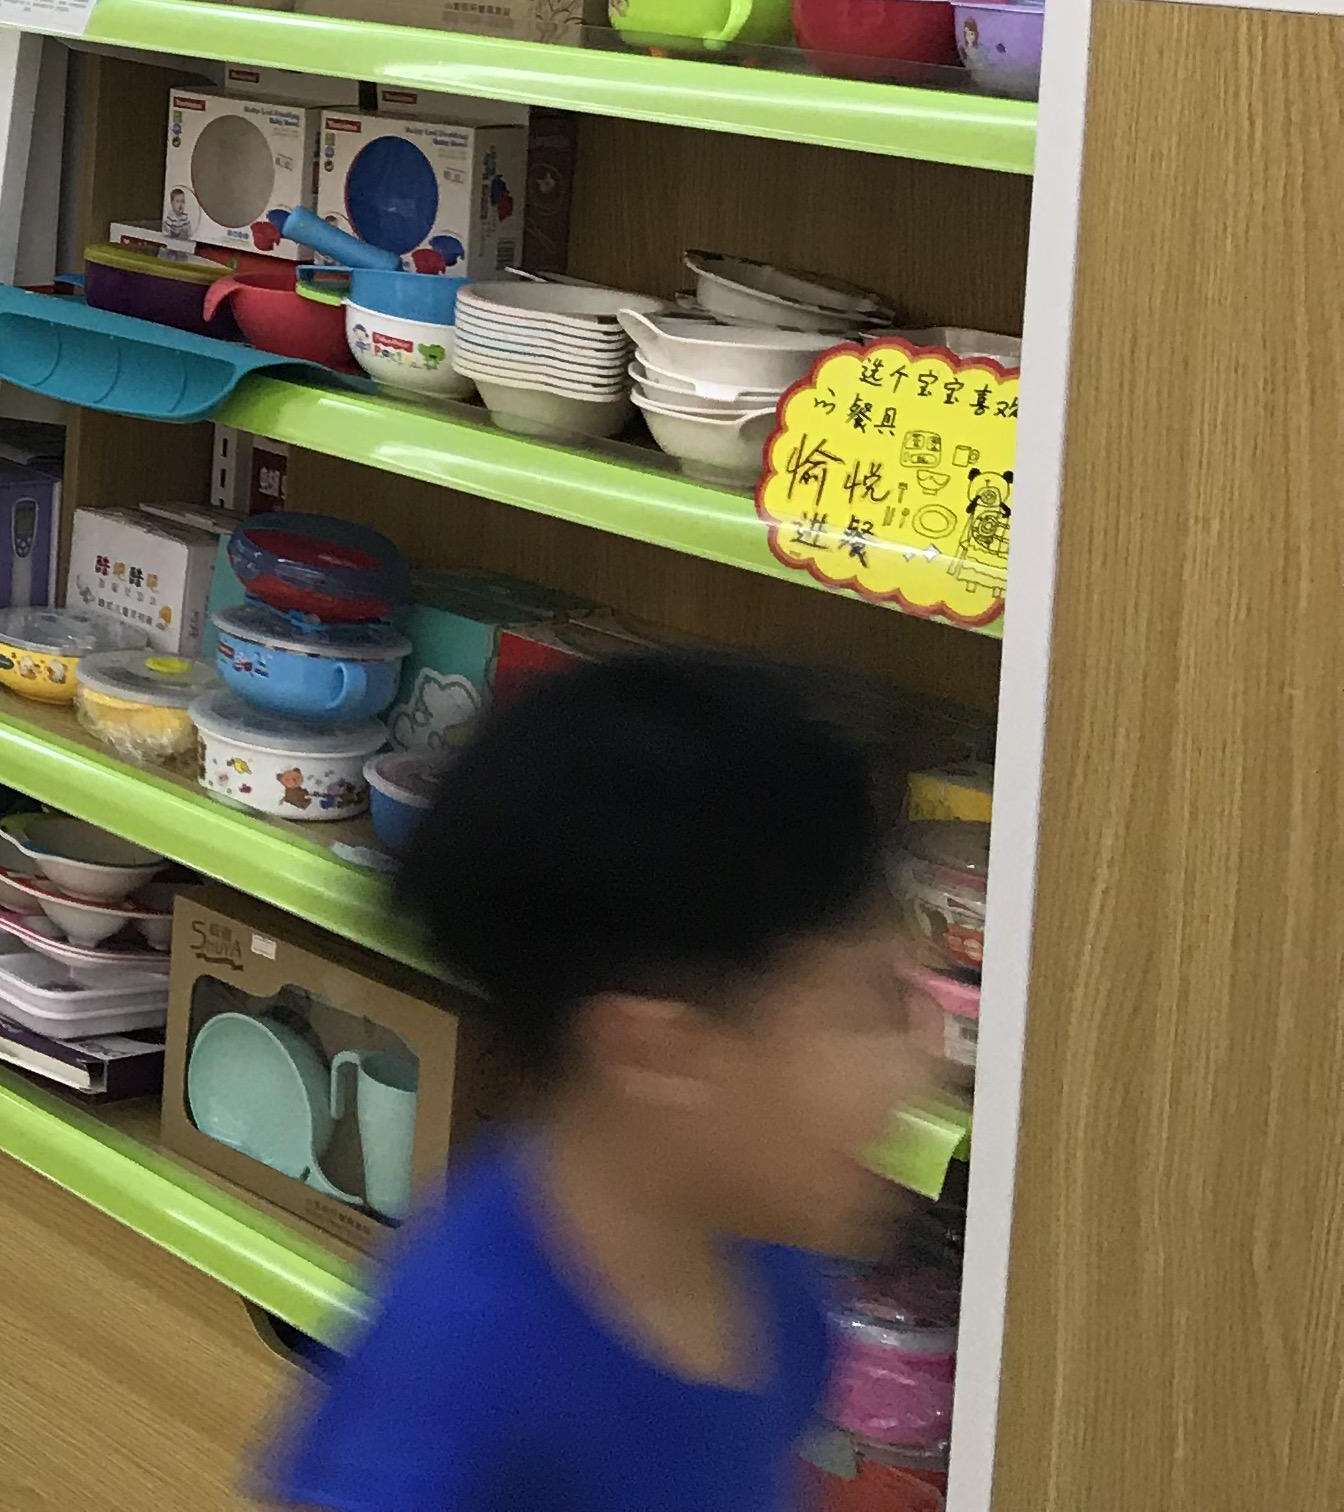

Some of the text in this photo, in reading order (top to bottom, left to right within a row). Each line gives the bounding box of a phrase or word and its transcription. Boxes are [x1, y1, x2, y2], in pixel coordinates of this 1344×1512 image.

[859, 357, 1020, 419] 选个宝宝喜欢
[785, 432, 891, 506] 愉悦
[791, 511, 876, 568] 进餐
